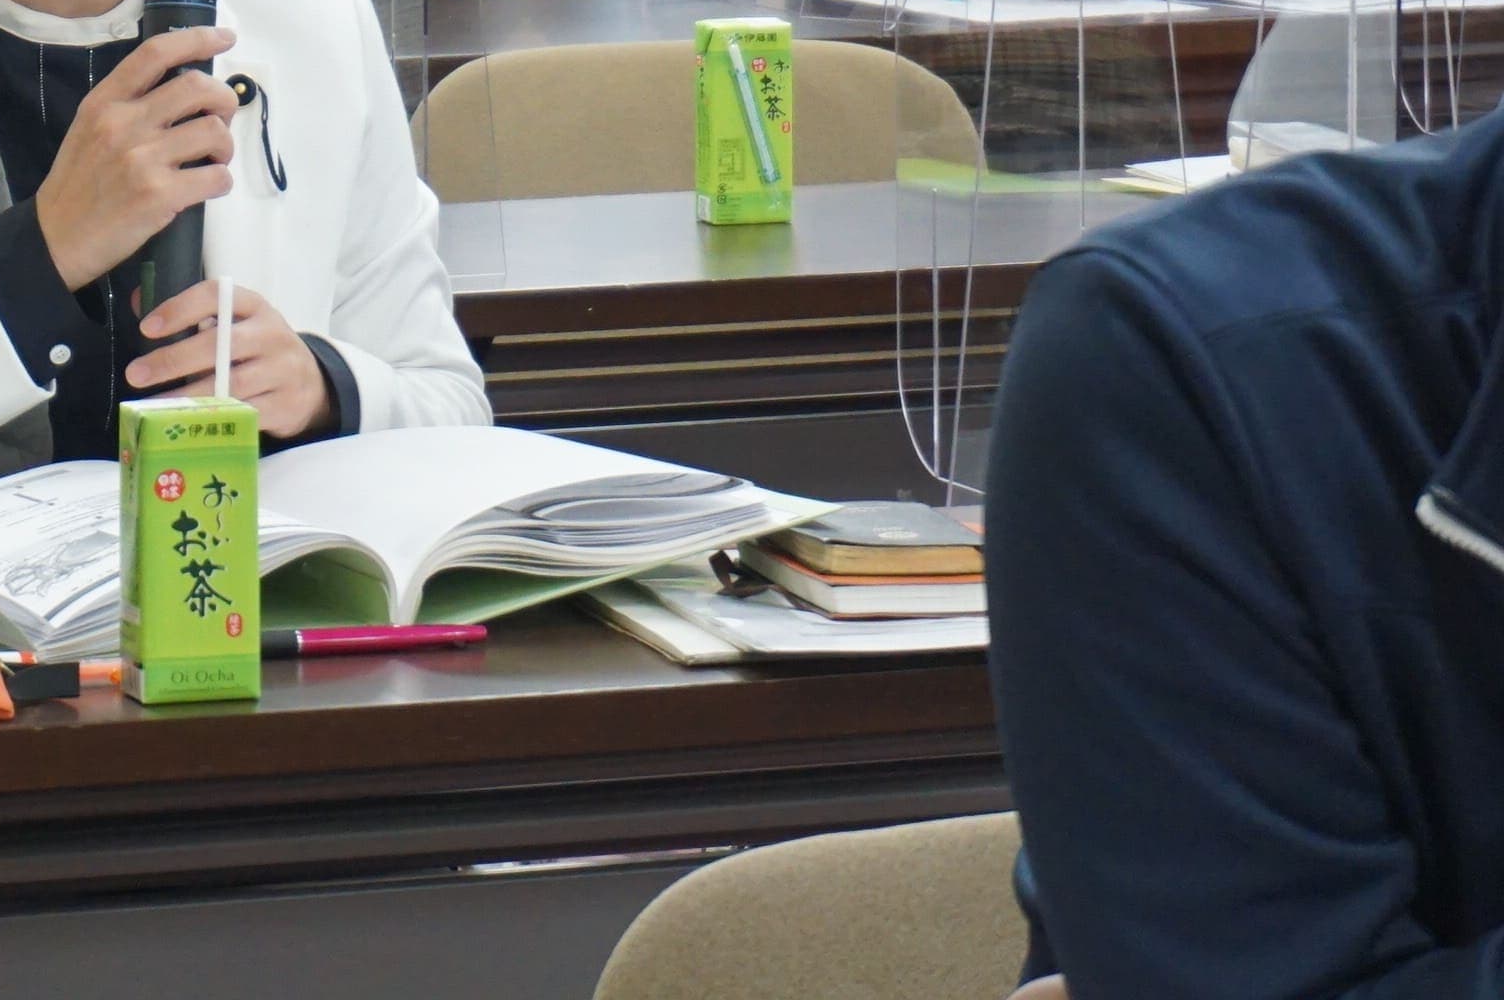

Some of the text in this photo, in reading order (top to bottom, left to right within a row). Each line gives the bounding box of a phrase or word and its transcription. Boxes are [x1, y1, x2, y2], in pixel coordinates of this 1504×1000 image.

[759, 74, 787, 121] お茶
[188, 422, 236, 437] 伊藤園
[171, 509, 233, 618] お茶
[171, 668, 236, 684] Oi Ocha
